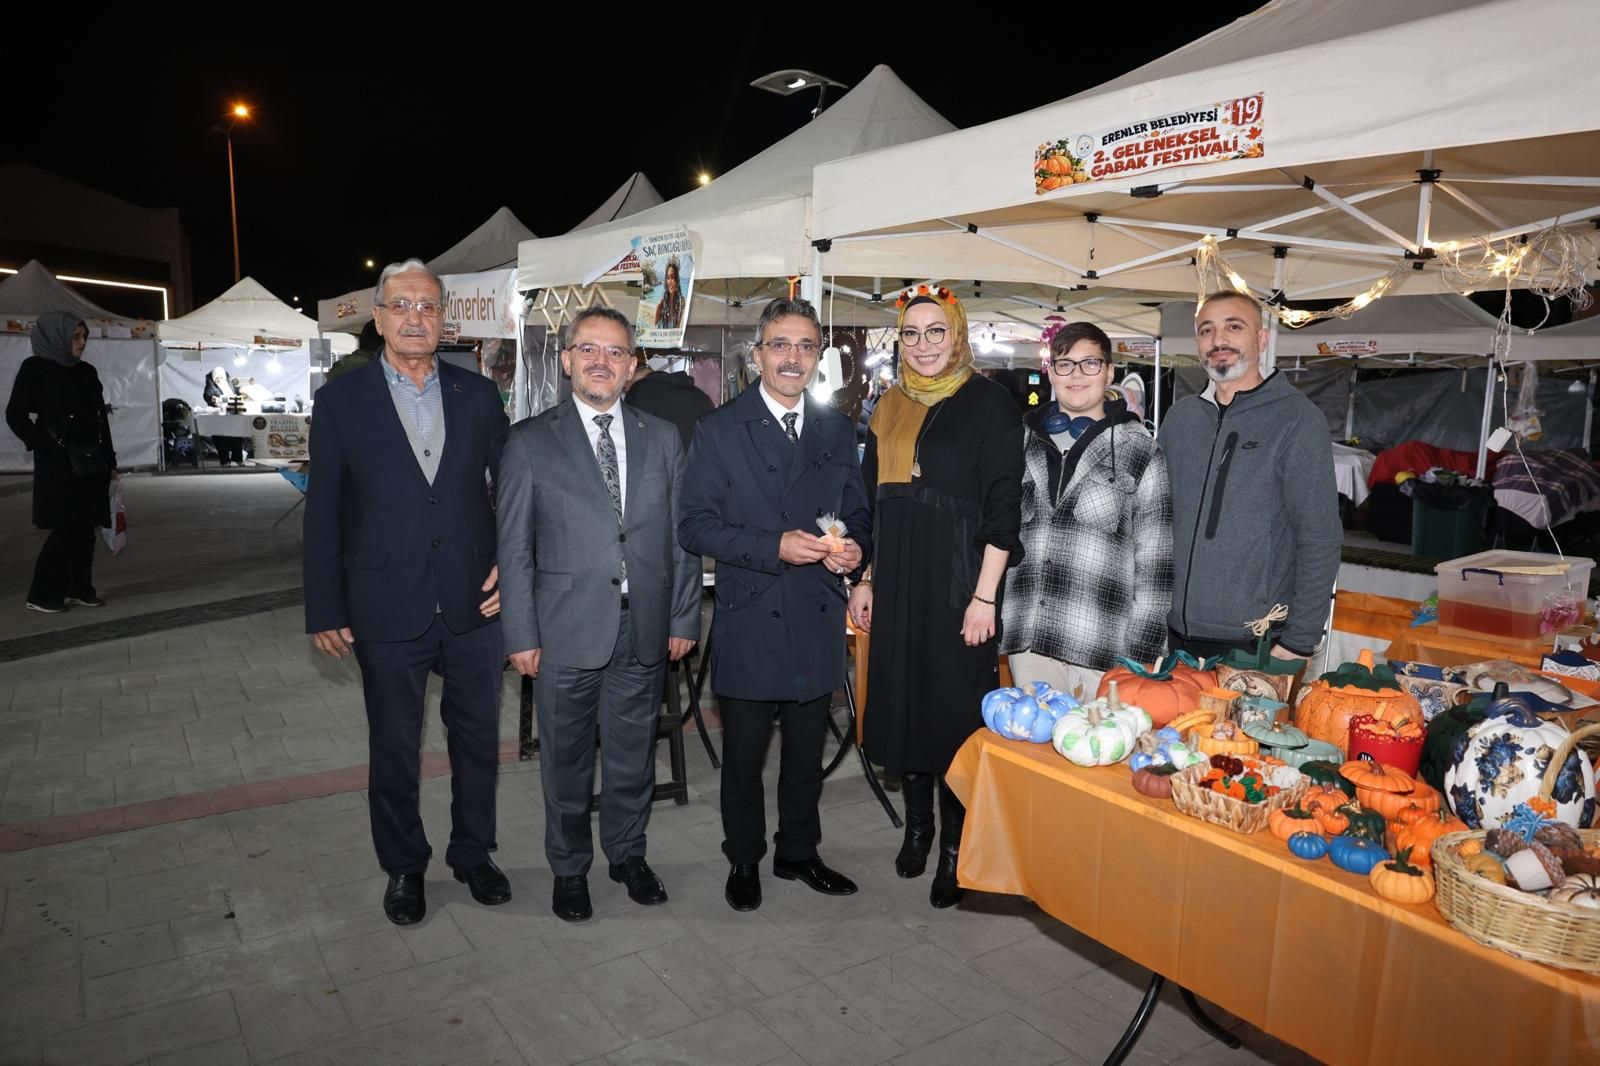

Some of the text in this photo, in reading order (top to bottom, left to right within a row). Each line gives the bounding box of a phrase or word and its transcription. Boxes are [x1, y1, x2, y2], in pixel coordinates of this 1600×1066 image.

[1102, 108, 1217, 146] ERENLER BELEDİYESİ
[1237, 97, 1259, 124] 19
[1090, 136, 1239, 177] GABAK FESTİVALİ
[1093, 127, 1220, 164] 2. GELENEKSEL
